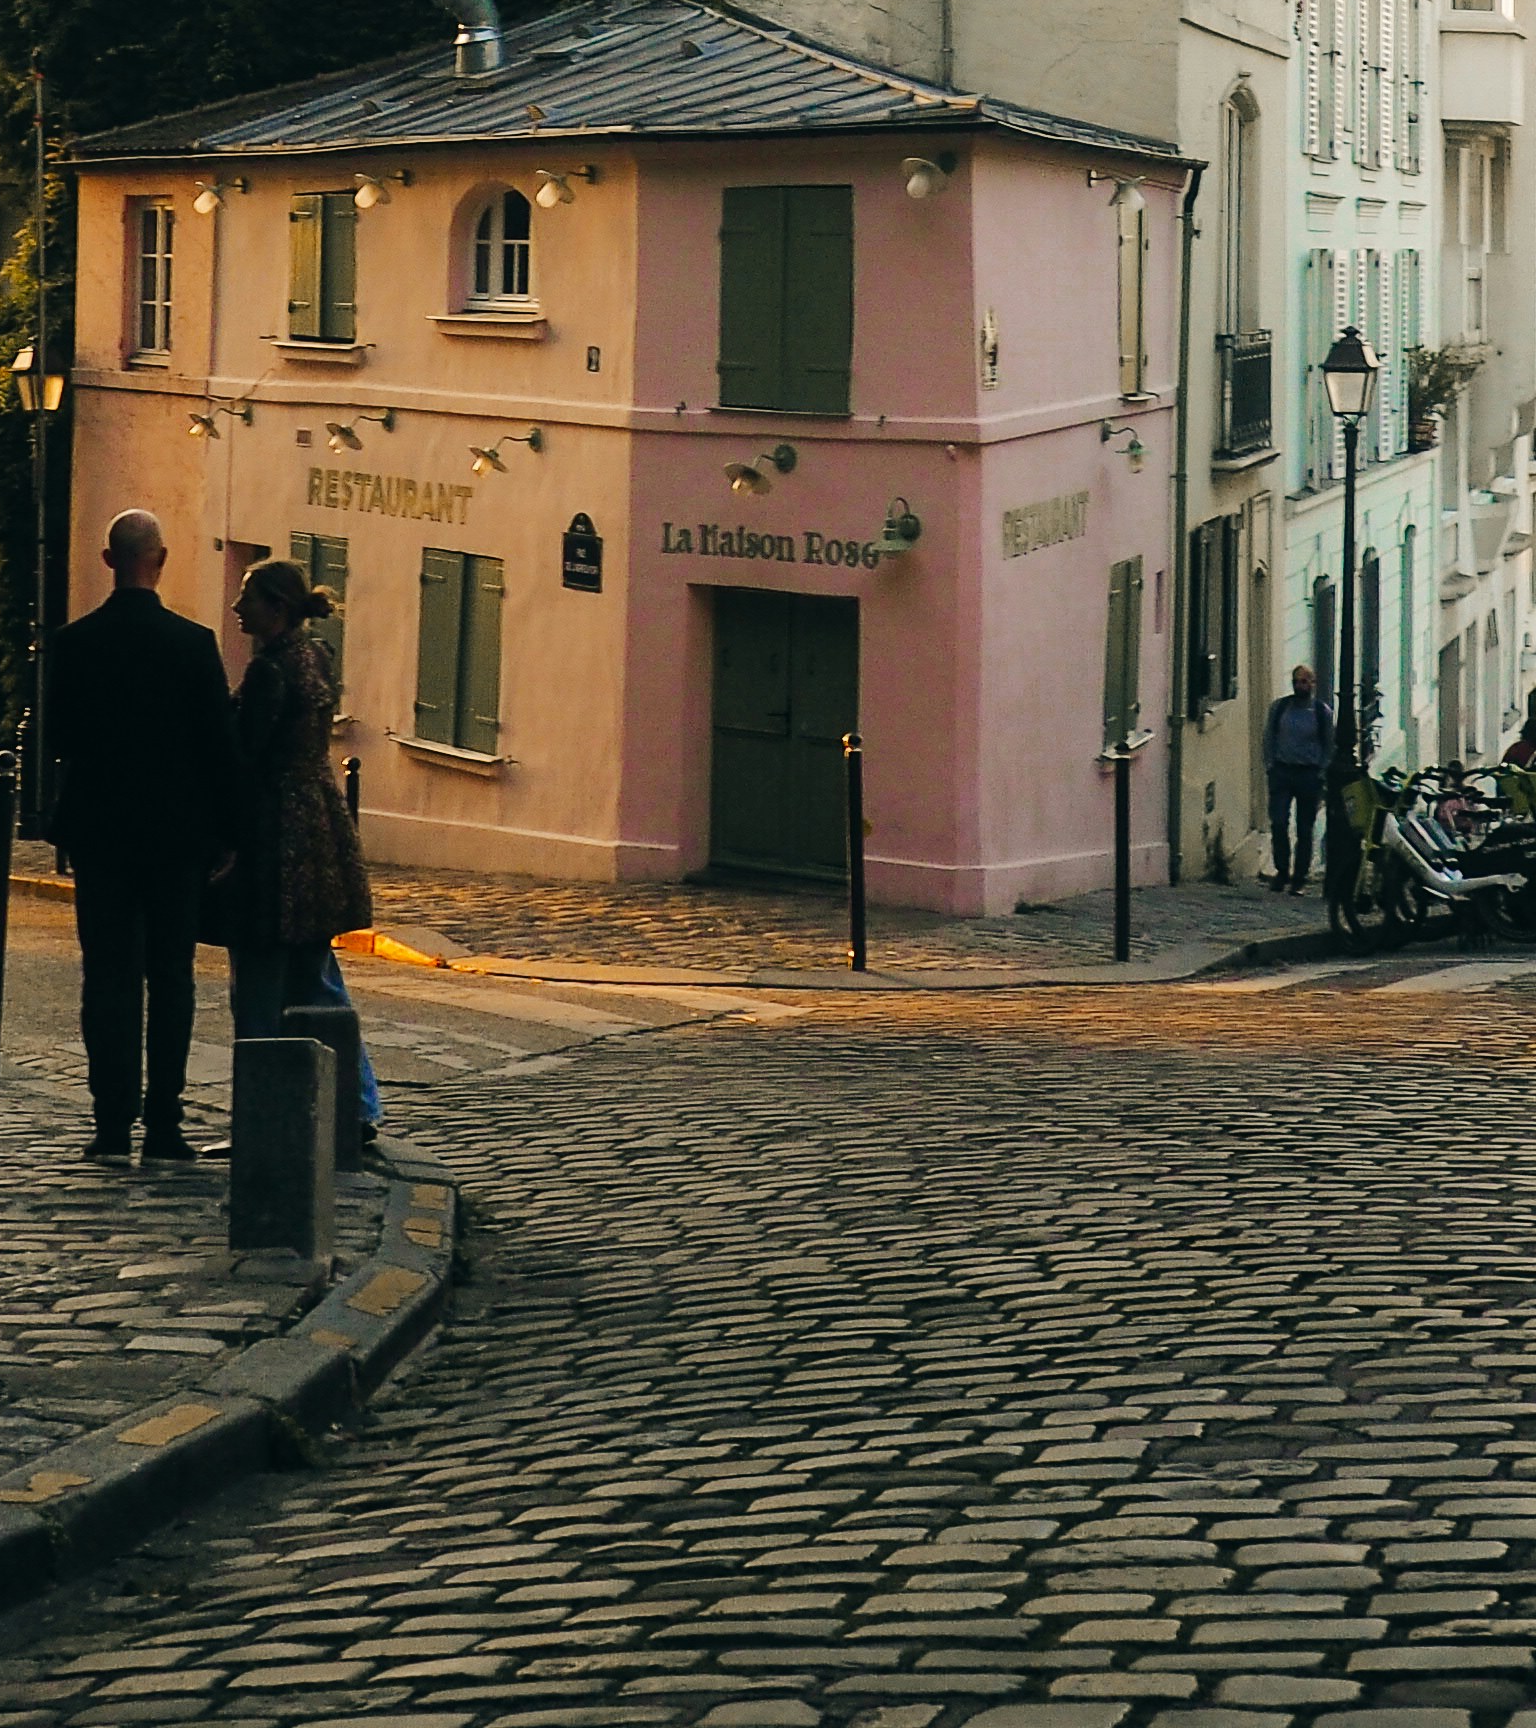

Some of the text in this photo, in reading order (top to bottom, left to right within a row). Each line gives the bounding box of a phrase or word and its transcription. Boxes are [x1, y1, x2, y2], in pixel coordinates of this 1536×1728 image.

[308, 467, 474, 524] RESTAURANT
[662, 522, 881, 569] La Maison Rose
